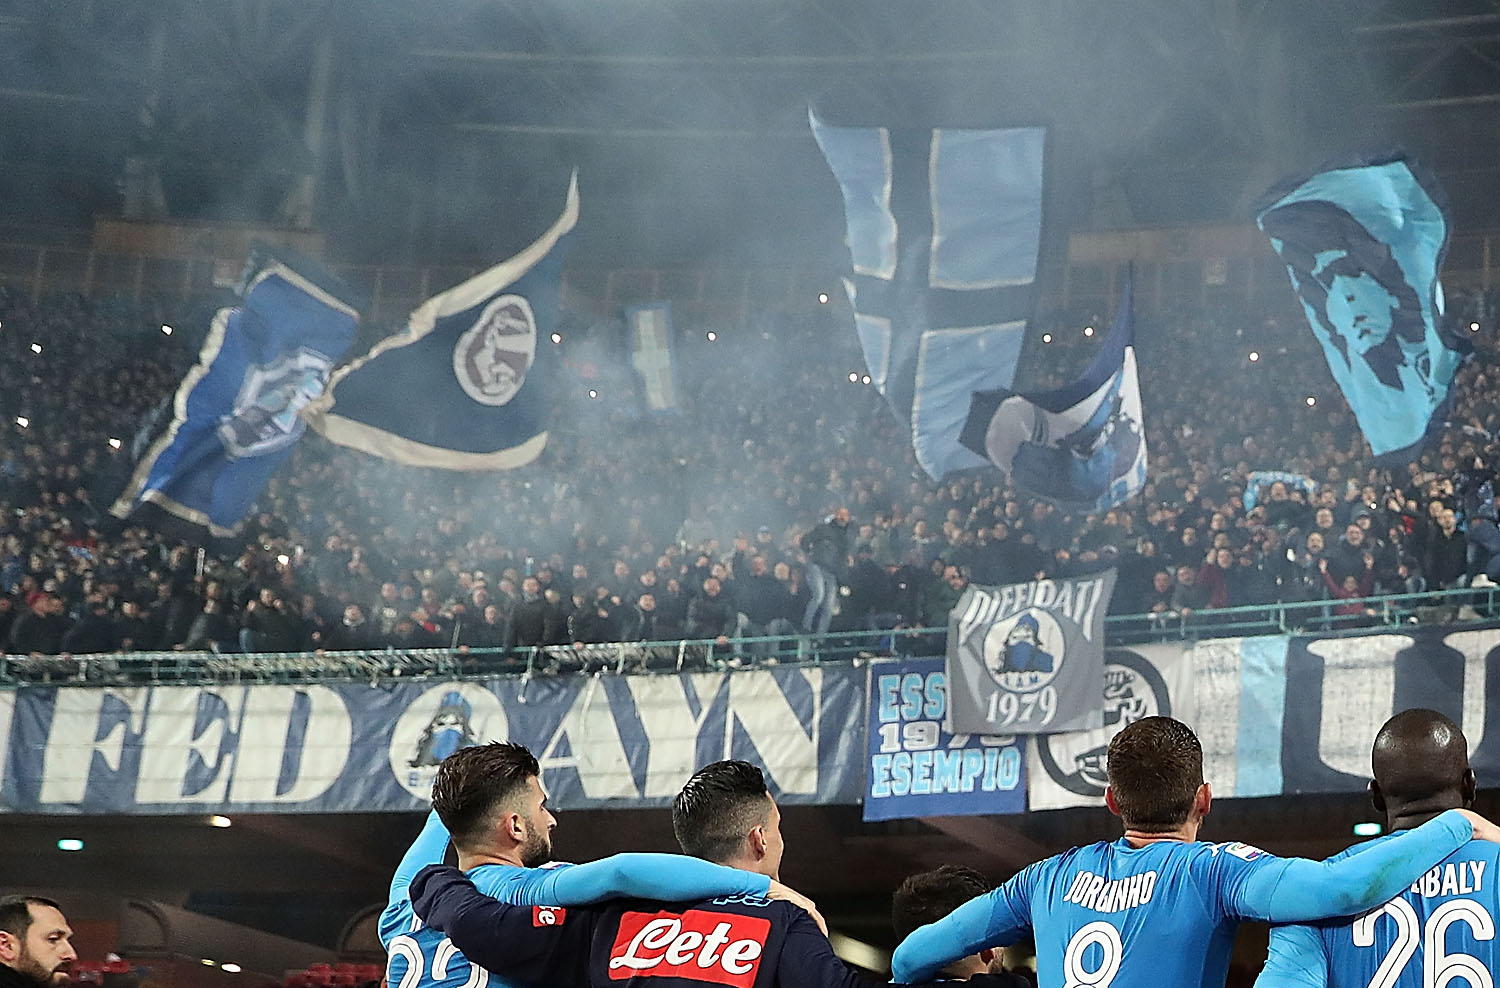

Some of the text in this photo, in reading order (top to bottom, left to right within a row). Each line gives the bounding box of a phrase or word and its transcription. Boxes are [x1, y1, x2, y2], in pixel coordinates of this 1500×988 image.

[958, 578, 1104, 647] DIFFIDATI
[878, 671, 946, 722] ESS
[985, 685, 1058, 727] 1979
[871, 746, 1021, 798] ESEMPIO
[1063, 870, 1158, 913] JORGINHO
[609, 917, 763, 975] Lete
